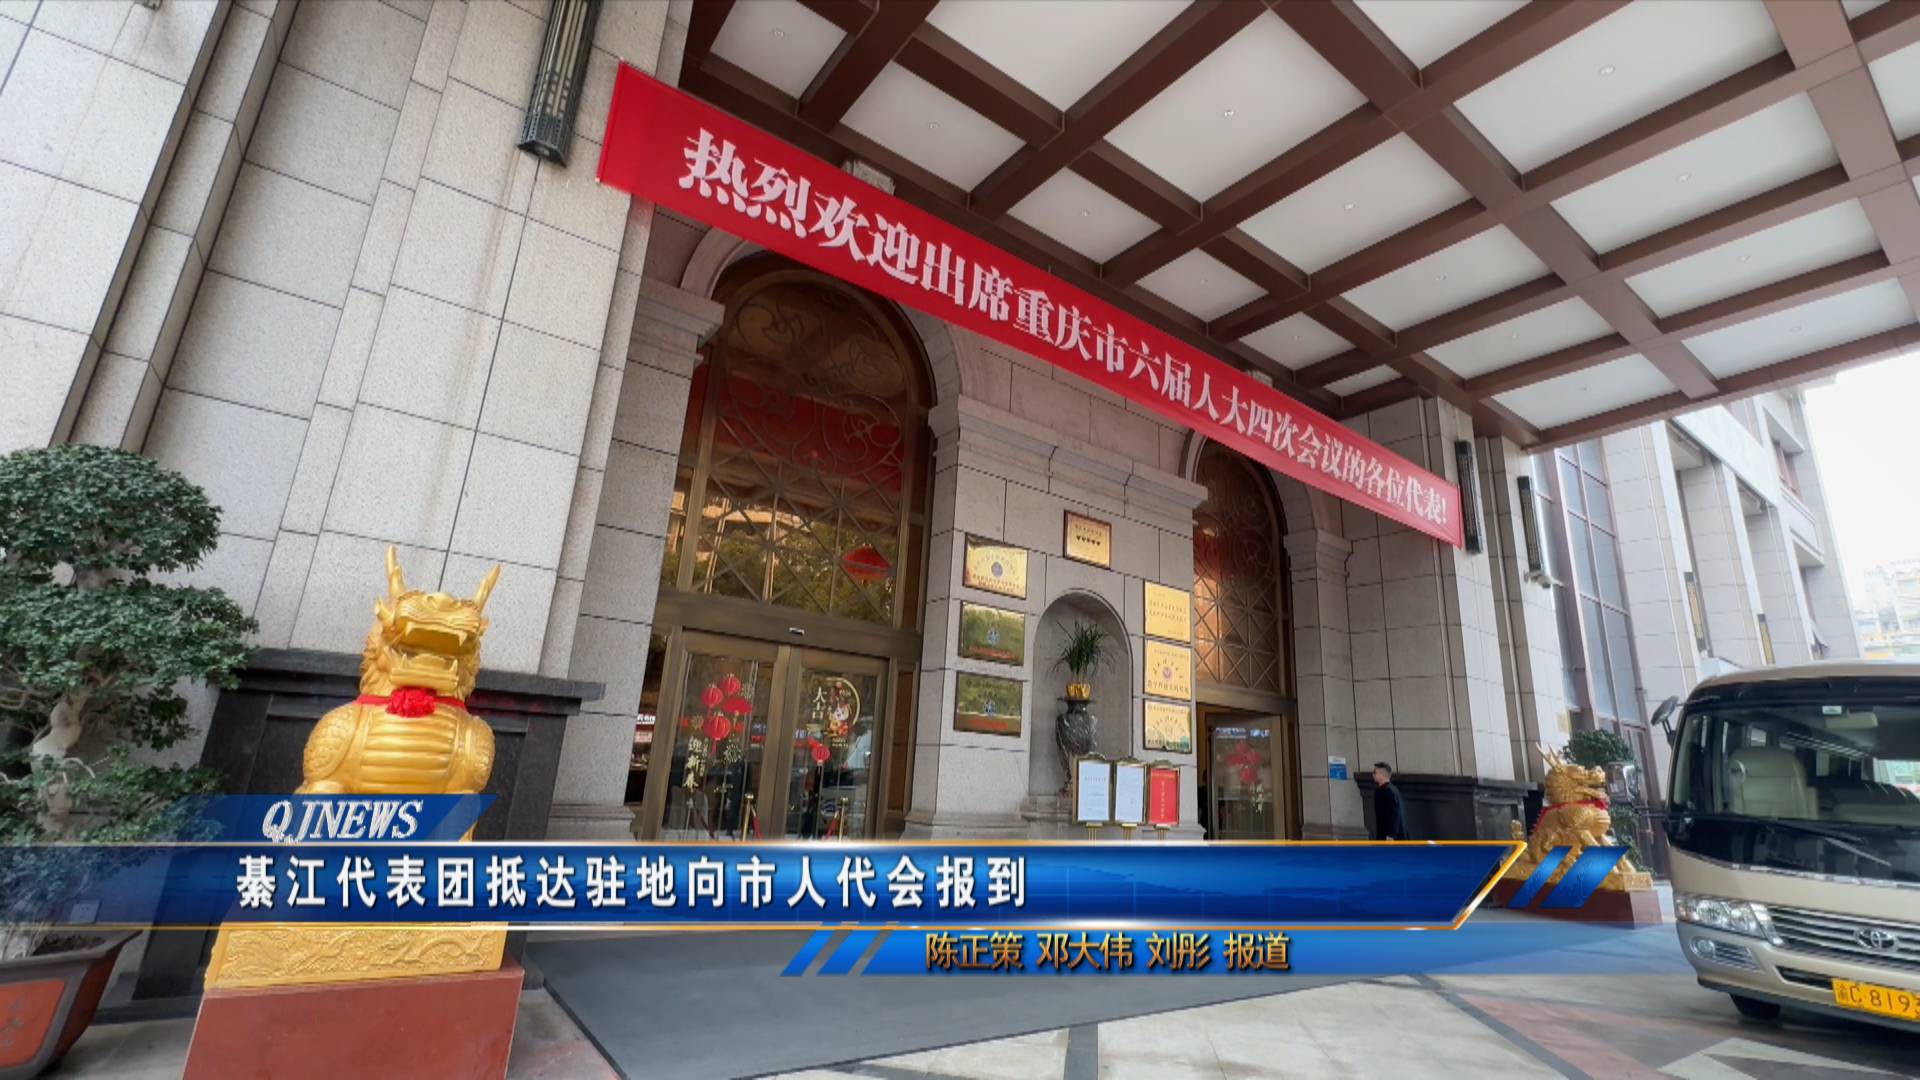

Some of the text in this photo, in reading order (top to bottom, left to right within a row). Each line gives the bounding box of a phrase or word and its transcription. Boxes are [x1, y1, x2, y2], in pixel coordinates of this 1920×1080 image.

[677, 128, 1447, 525] 热烈欢迎出席重庆市六届人大四次会议的各位代表！
